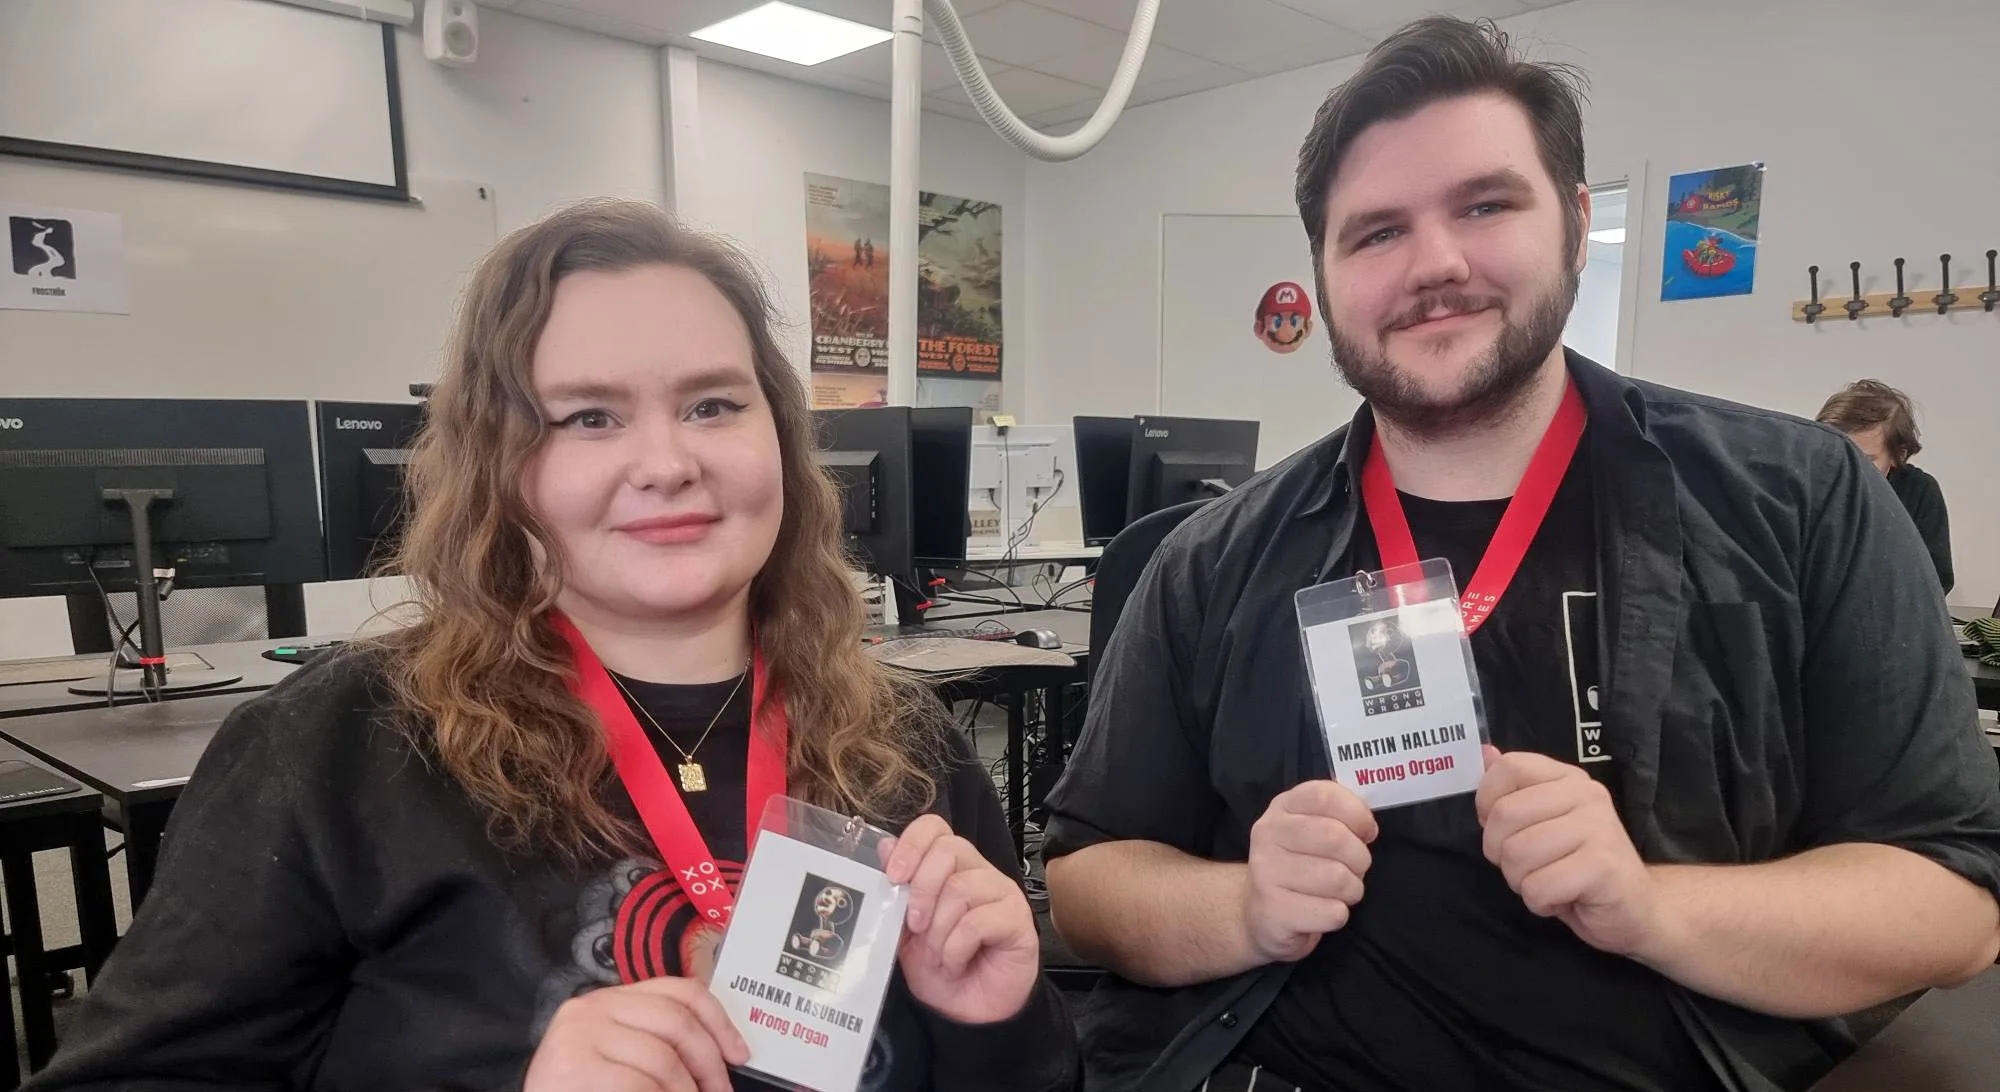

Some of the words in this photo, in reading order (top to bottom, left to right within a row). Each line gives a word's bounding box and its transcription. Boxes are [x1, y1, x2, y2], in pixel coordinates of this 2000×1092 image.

[815, 335, 885, 348] CRANBERRY
[816, 345, 854, 354] WEST
[919, 339, 947, 352] THE
[948, 341, 999, 356] FOREST
[336, 416, 382, 430] Lenovo
[1144, 427, 1169, 438] Lenovo
[1365, 691, 1422, 707] WRONG
[1368, 699, 1423, 715] ORGAN
[1337, 736, 1397, 762] MARTIN
[1401, 723, 1467, 751] HALLDIN
[1354, 763, 1406, 786] Wrong
[1408, 754, 1455, 777] Organ
[730, 975, 793, 1008] JOHANNA
[795, 995, 864, 1034] KASURINEN
[749, 1006, 792, 1036] Wrong
[792, 1021, 830, 1048] Organ
